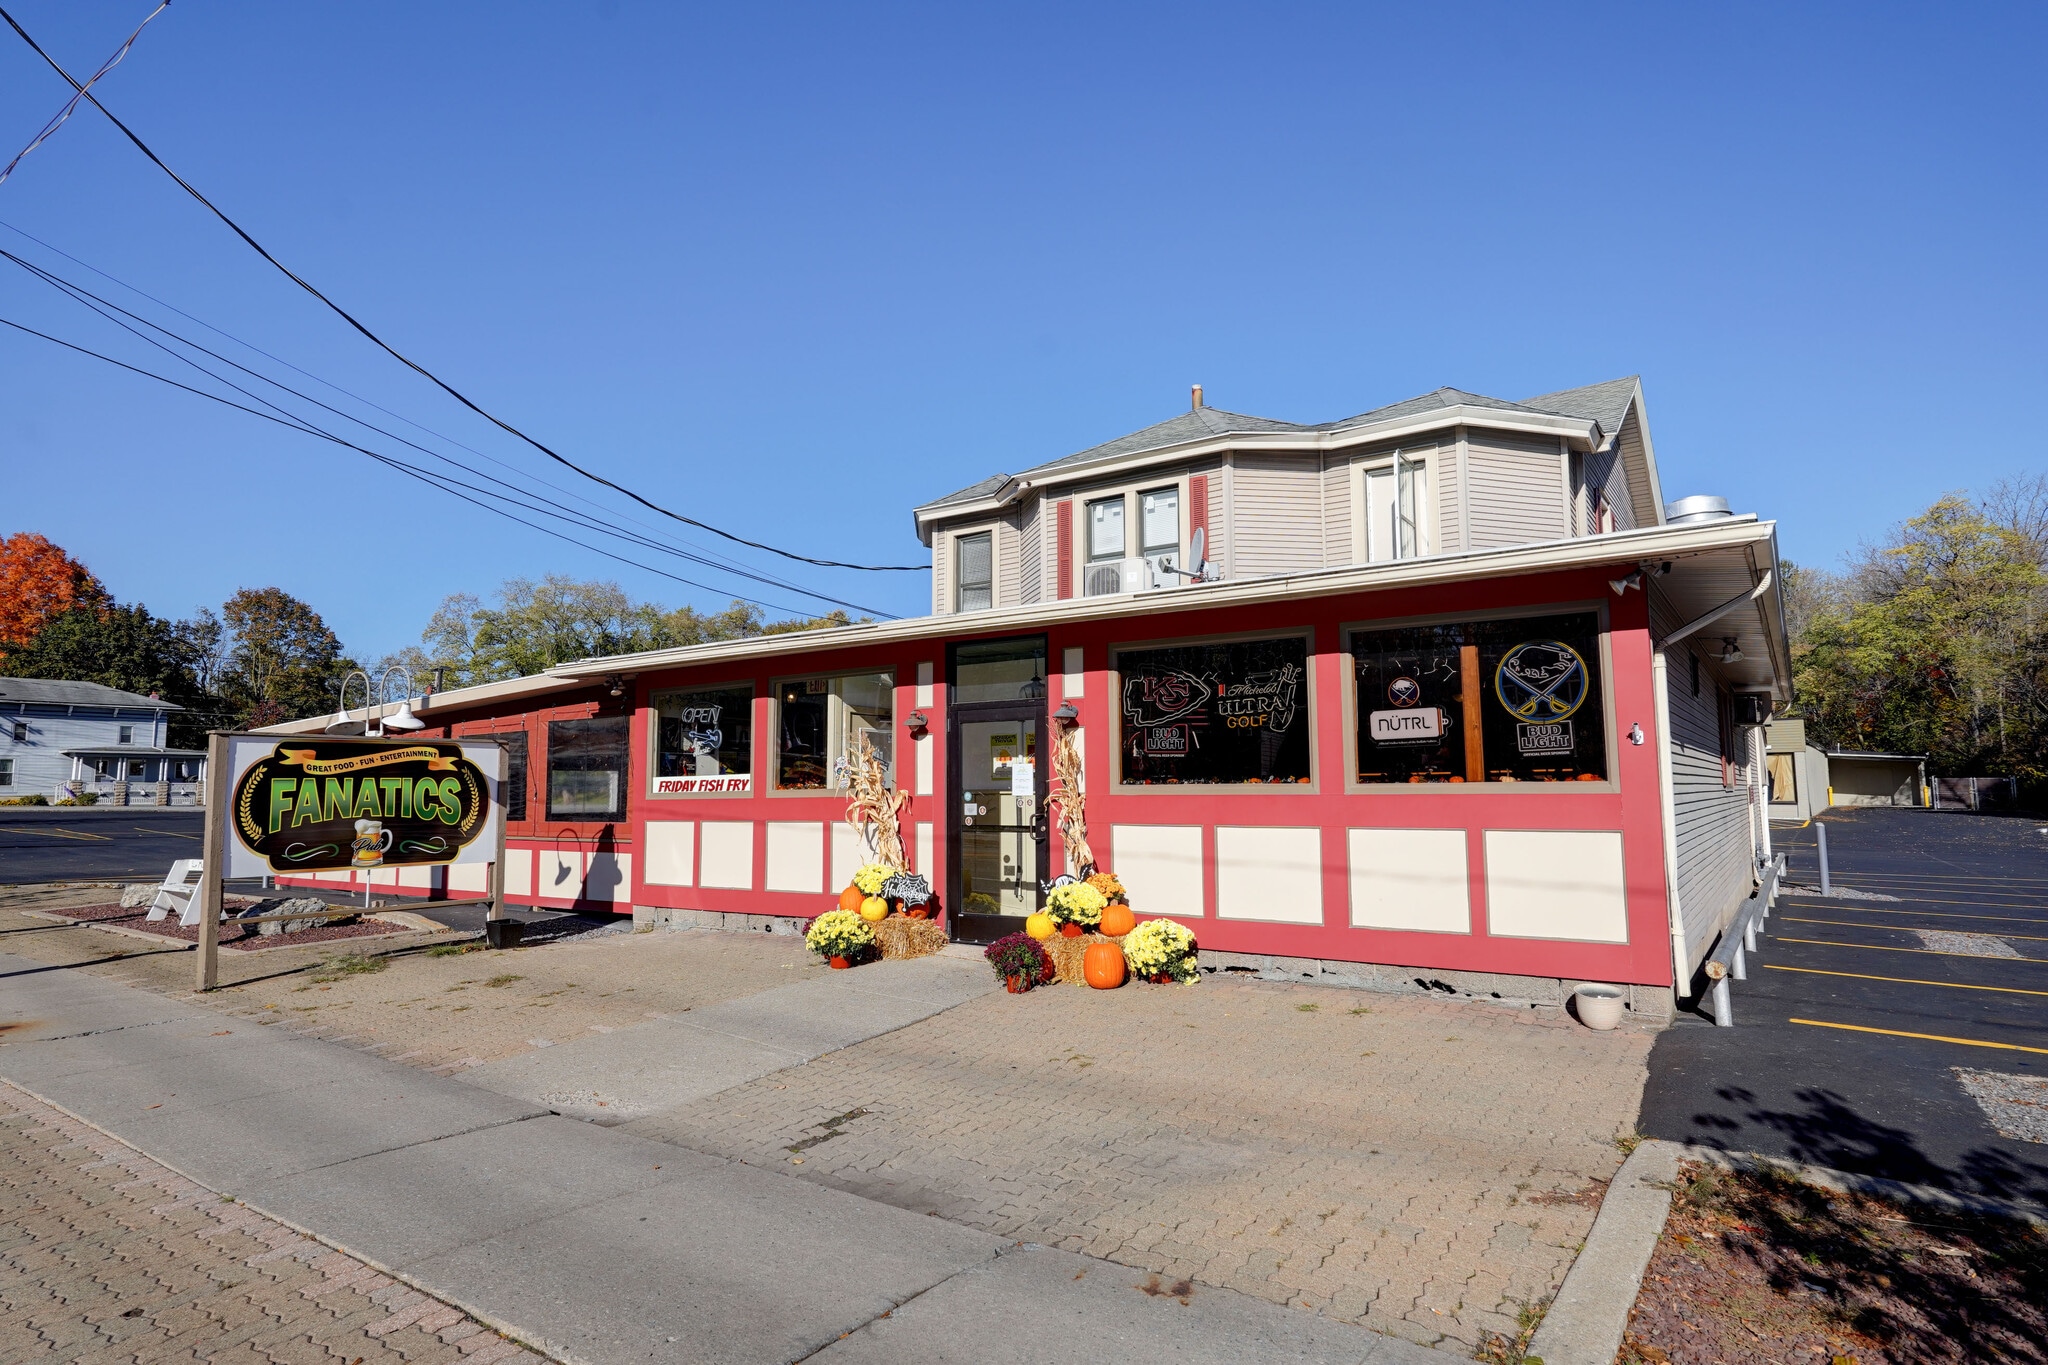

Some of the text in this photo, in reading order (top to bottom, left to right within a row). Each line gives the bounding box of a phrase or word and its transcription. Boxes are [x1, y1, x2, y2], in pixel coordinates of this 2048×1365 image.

[1143, 677, 1189, 712] KC
[1228, 682, 1277, 697] Michelob
[1217, 696, 1285, 716] ULTRA
[682, 706, 721, 723] OPEN
[1226, 714, 1268, 729] GOLF
[1152, 727, 1180, 739] BUD
[1527, 725, 1562, 738] BUD
[1147, 738, 1185, 750] LIGHT
[1521, 735, 1570, 749] LIGHT
[306, 750, 438, 773] GREAT FOOD FUN ENTERTAINMENT
[658, 778, 750, 793] FRIDAY FISH FRY
[269, 777, 462, 834] FANATICS
[351, 838, 384, 855] Pub
